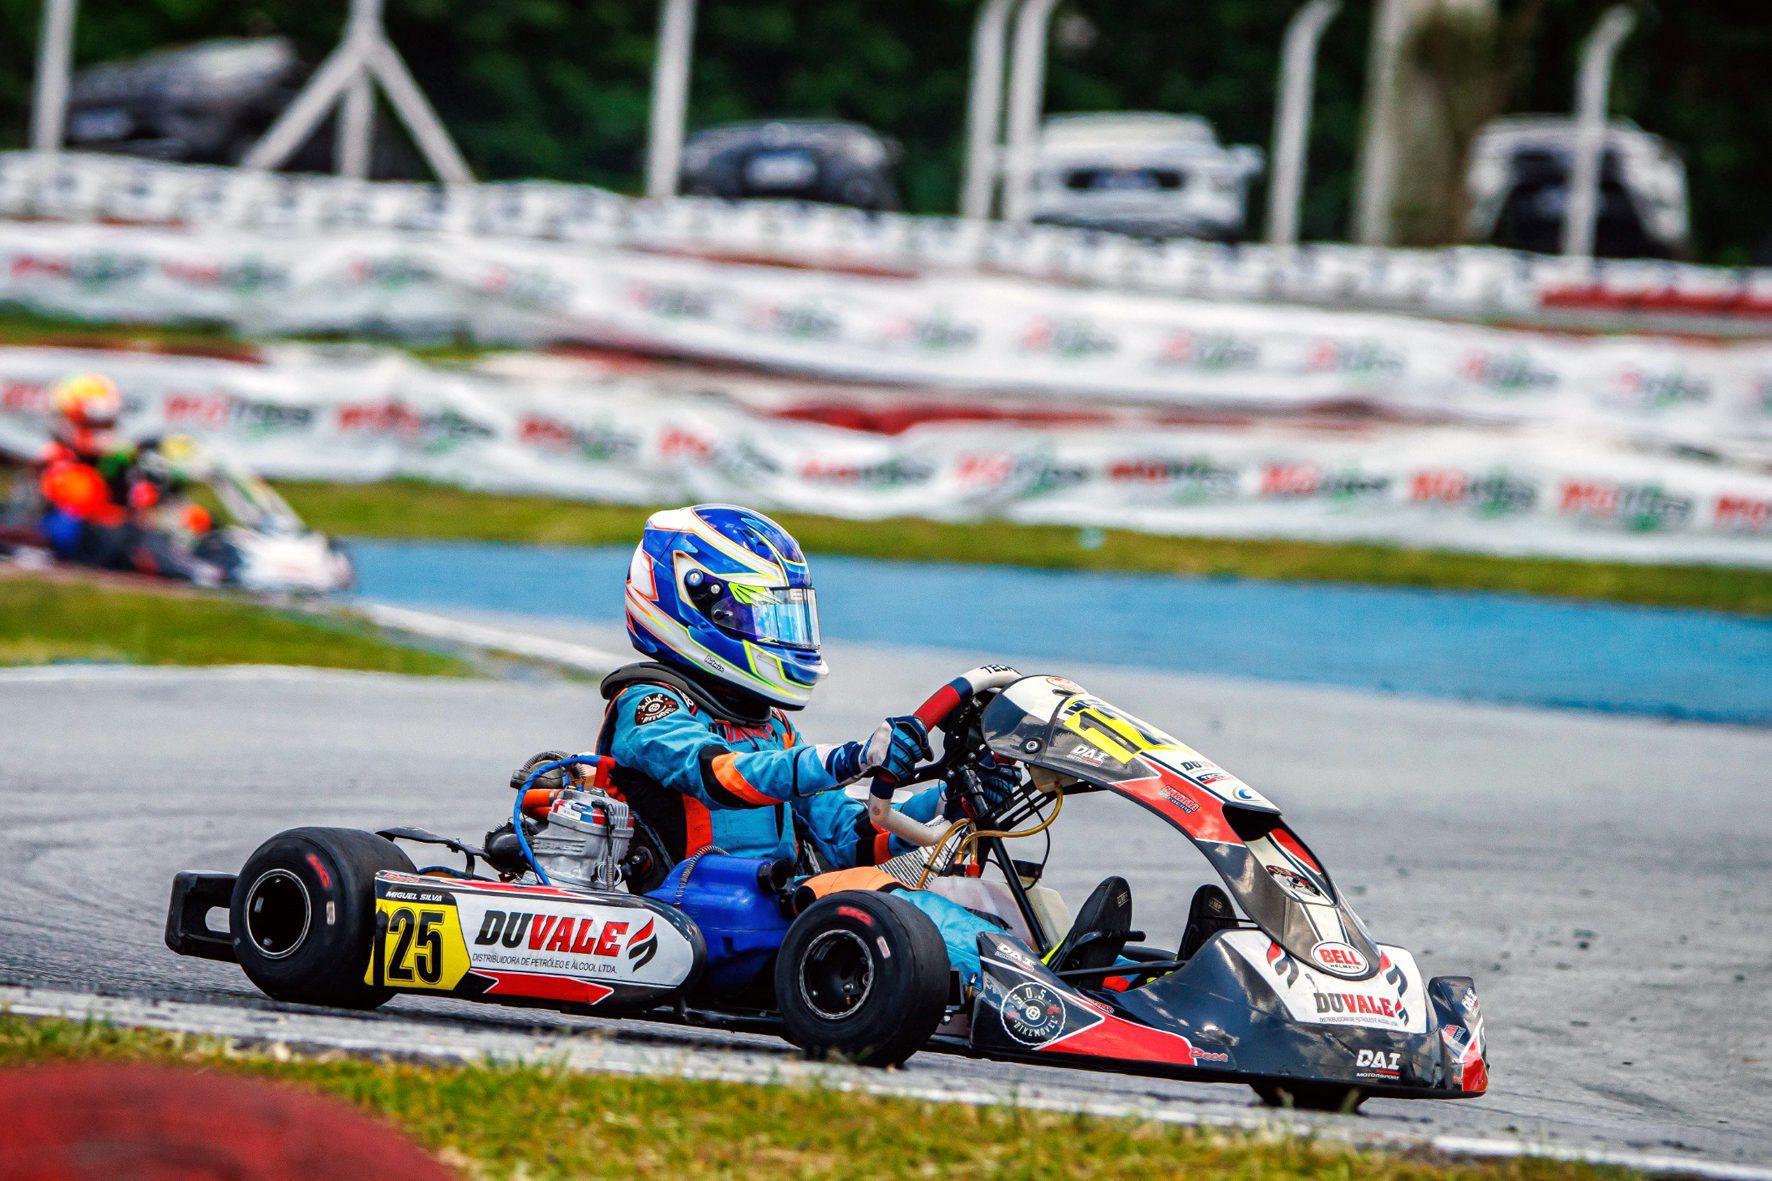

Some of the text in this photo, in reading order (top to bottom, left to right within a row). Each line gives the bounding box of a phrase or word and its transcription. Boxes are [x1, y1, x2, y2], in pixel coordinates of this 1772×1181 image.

[385, 891, 442, 902] MIGUEL SILVA
[474, 910, 630, 957] DUVALE
[472, 953, 520, 965] DISTRIBUIDORA
[521, 957, 531, 966] DE
[531, 957, 565, 969] PETRÓLEO
[565, 961, 570, 969] E
[1318, 949, 1361, 966] BELL
[1313, 992, 1395, 1018] DUVALE
[1356, 1049, 1401, 1070] DAI
[1356, 1072, 1400, 1080] MOTORSPORT
